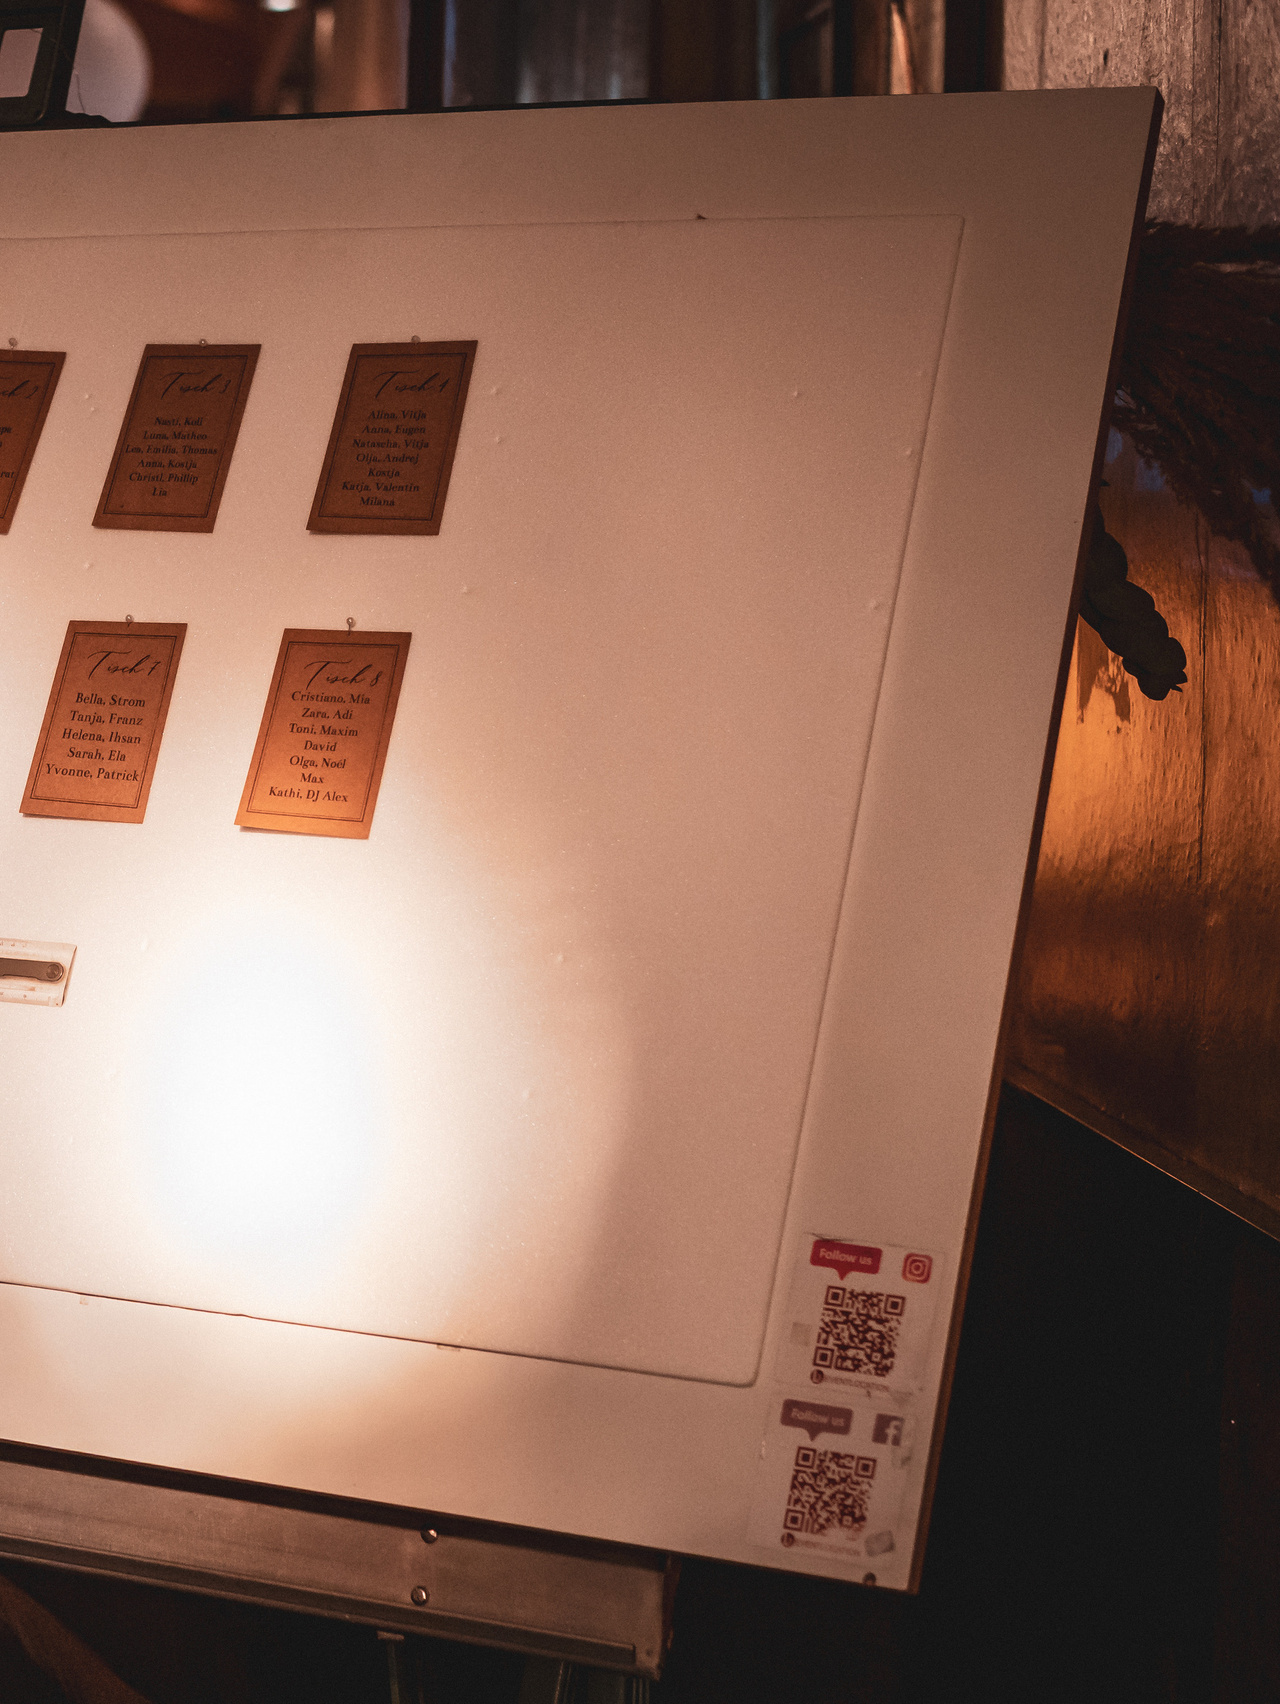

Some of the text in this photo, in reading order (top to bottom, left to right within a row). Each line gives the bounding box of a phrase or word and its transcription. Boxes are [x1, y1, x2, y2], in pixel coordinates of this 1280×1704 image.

[160, 369, 231, 400] Tisch 3
[373, 369, 439, 399] Tisch
[368, 410, 427, 421] Alina, Vitja
[144, 431, 168, 440] Luna,
[362, 425, 426, 435] Anna, Eugen
[147, 445, 178, 454] Emilia,
[182, 445, 217, 455] Thomas
[353, 439, 429, 450] Natascha, Vitja
[137, 459, 197, 471] Anna, Kostja
[356, 453, 419, 465] Olja, Andrej
[168, 473, 199, 485] Phillip
[368, 468, 400, 478] Kostja
[152, 487, 167, 496] Lia
[342, 482, 419, 493] Katja, Valentin
[360, 497, 395, 506] Milana
[87, 650, 161, 680] Tisch 7
[304, 660, 383, 690] Tisch 8
[76, 692, 146, 707] Bella, Strom
[292, 691, 370, 704] Cristiano, Mia
[70, 710, 143, 726] Tanja, Franz
[302, 708, 353, 719] Zara, Adi
[289, 723, 358, 736] Toni, Maxim
[62, 729, 141, 744] Helena, Ihsan
[304, 740, 337, 751] David
[67, 747, 126, 761] Sarah, Ela
[290, 755, 318, 768] Olga,
[46, 764, 139, 782] Yvonne, Patrick
[300, 773, 325, 783] Max
[269, 787, 348, 802] Kathi, DJ Alex
[820, 1248, 873, 1265] Follow us
